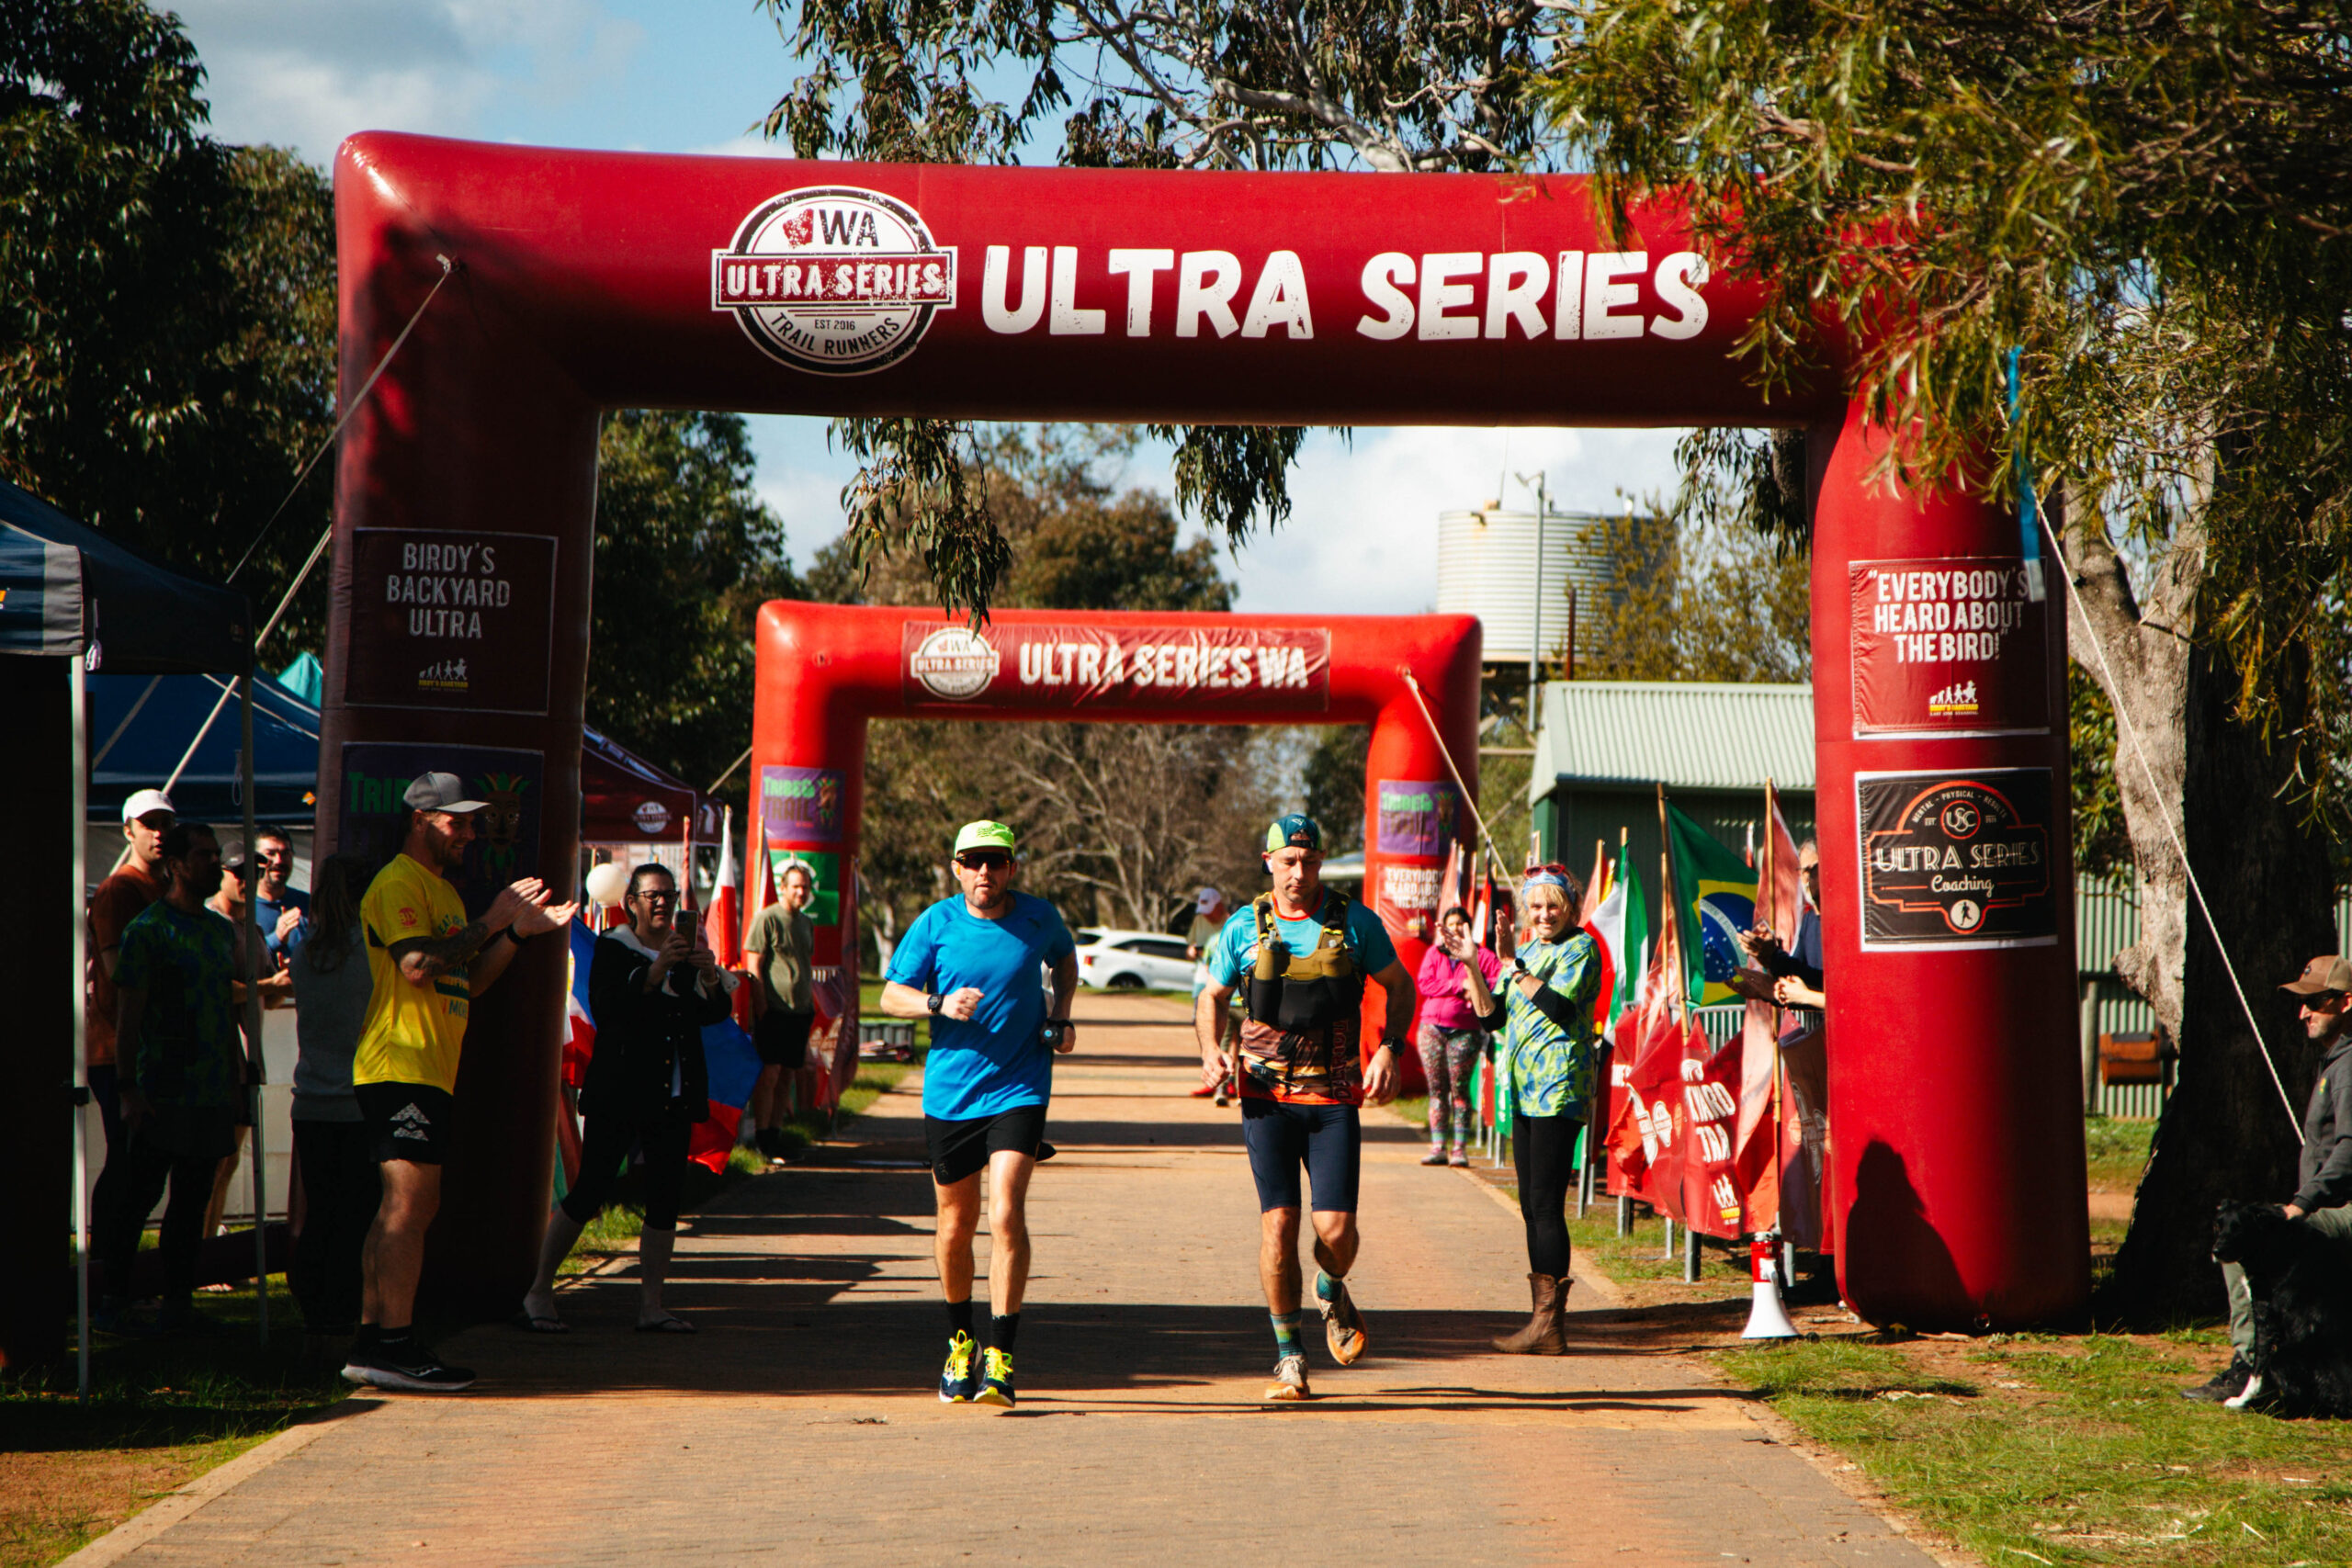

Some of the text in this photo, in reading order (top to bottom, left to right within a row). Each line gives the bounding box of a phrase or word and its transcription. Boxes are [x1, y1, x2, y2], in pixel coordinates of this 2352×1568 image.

[819, 209, 879, 247] WA
[727, 263, 945, 297] ULTRA SERIES
[981, 245, 1711, 341] ULTRA SERIES
[770, 312, 900, 355] TRAIL RUNNERS
[814, 319, 856, 331] EST 2016
[402, 542, 496, 574] BIRDY'S
[386, 574, 511, 608] BACKYARD
[409, 608, 483, 639] ULTRA
[1874, 602, 2025, 633] HEARD ABOUT
[1894, 633, 1938, 663] THE
[917, 658, 953, 671] ULTRA
[1019, 642, 1309, 689] ULTRA SERIES WA
[1911, 800, 1935, 824] MENTAL
[1940, 790, 1974, 801] PHYSICAL
[1875, 841, 2041, 872] ULTRA SERIES
[1931, 874, 1996, 897] Coaching
